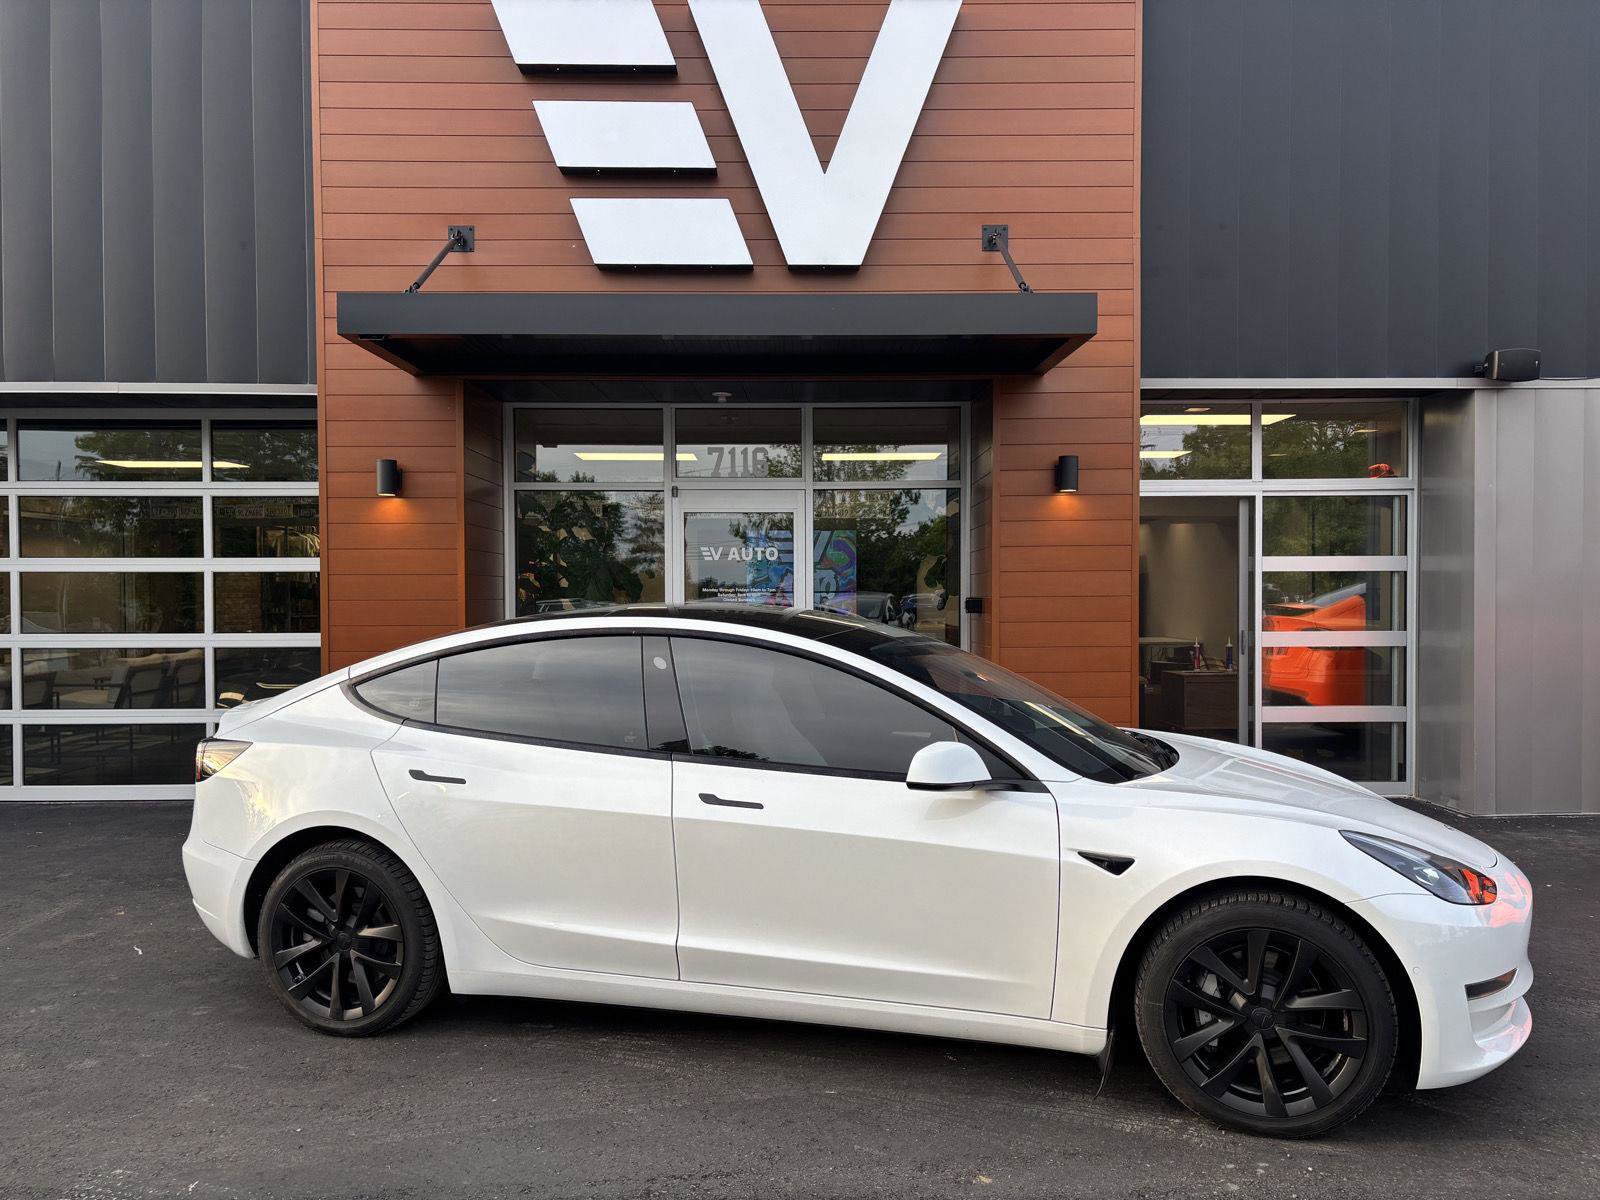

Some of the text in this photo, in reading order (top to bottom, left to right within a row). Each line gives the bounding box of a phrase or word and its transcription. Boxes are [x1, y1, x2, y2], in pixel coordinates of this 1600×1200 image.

[491, 0, 963, 268] EV
[707, 446, 769, 478] 7116
[700, 546, 779, 561] EV AUTO
